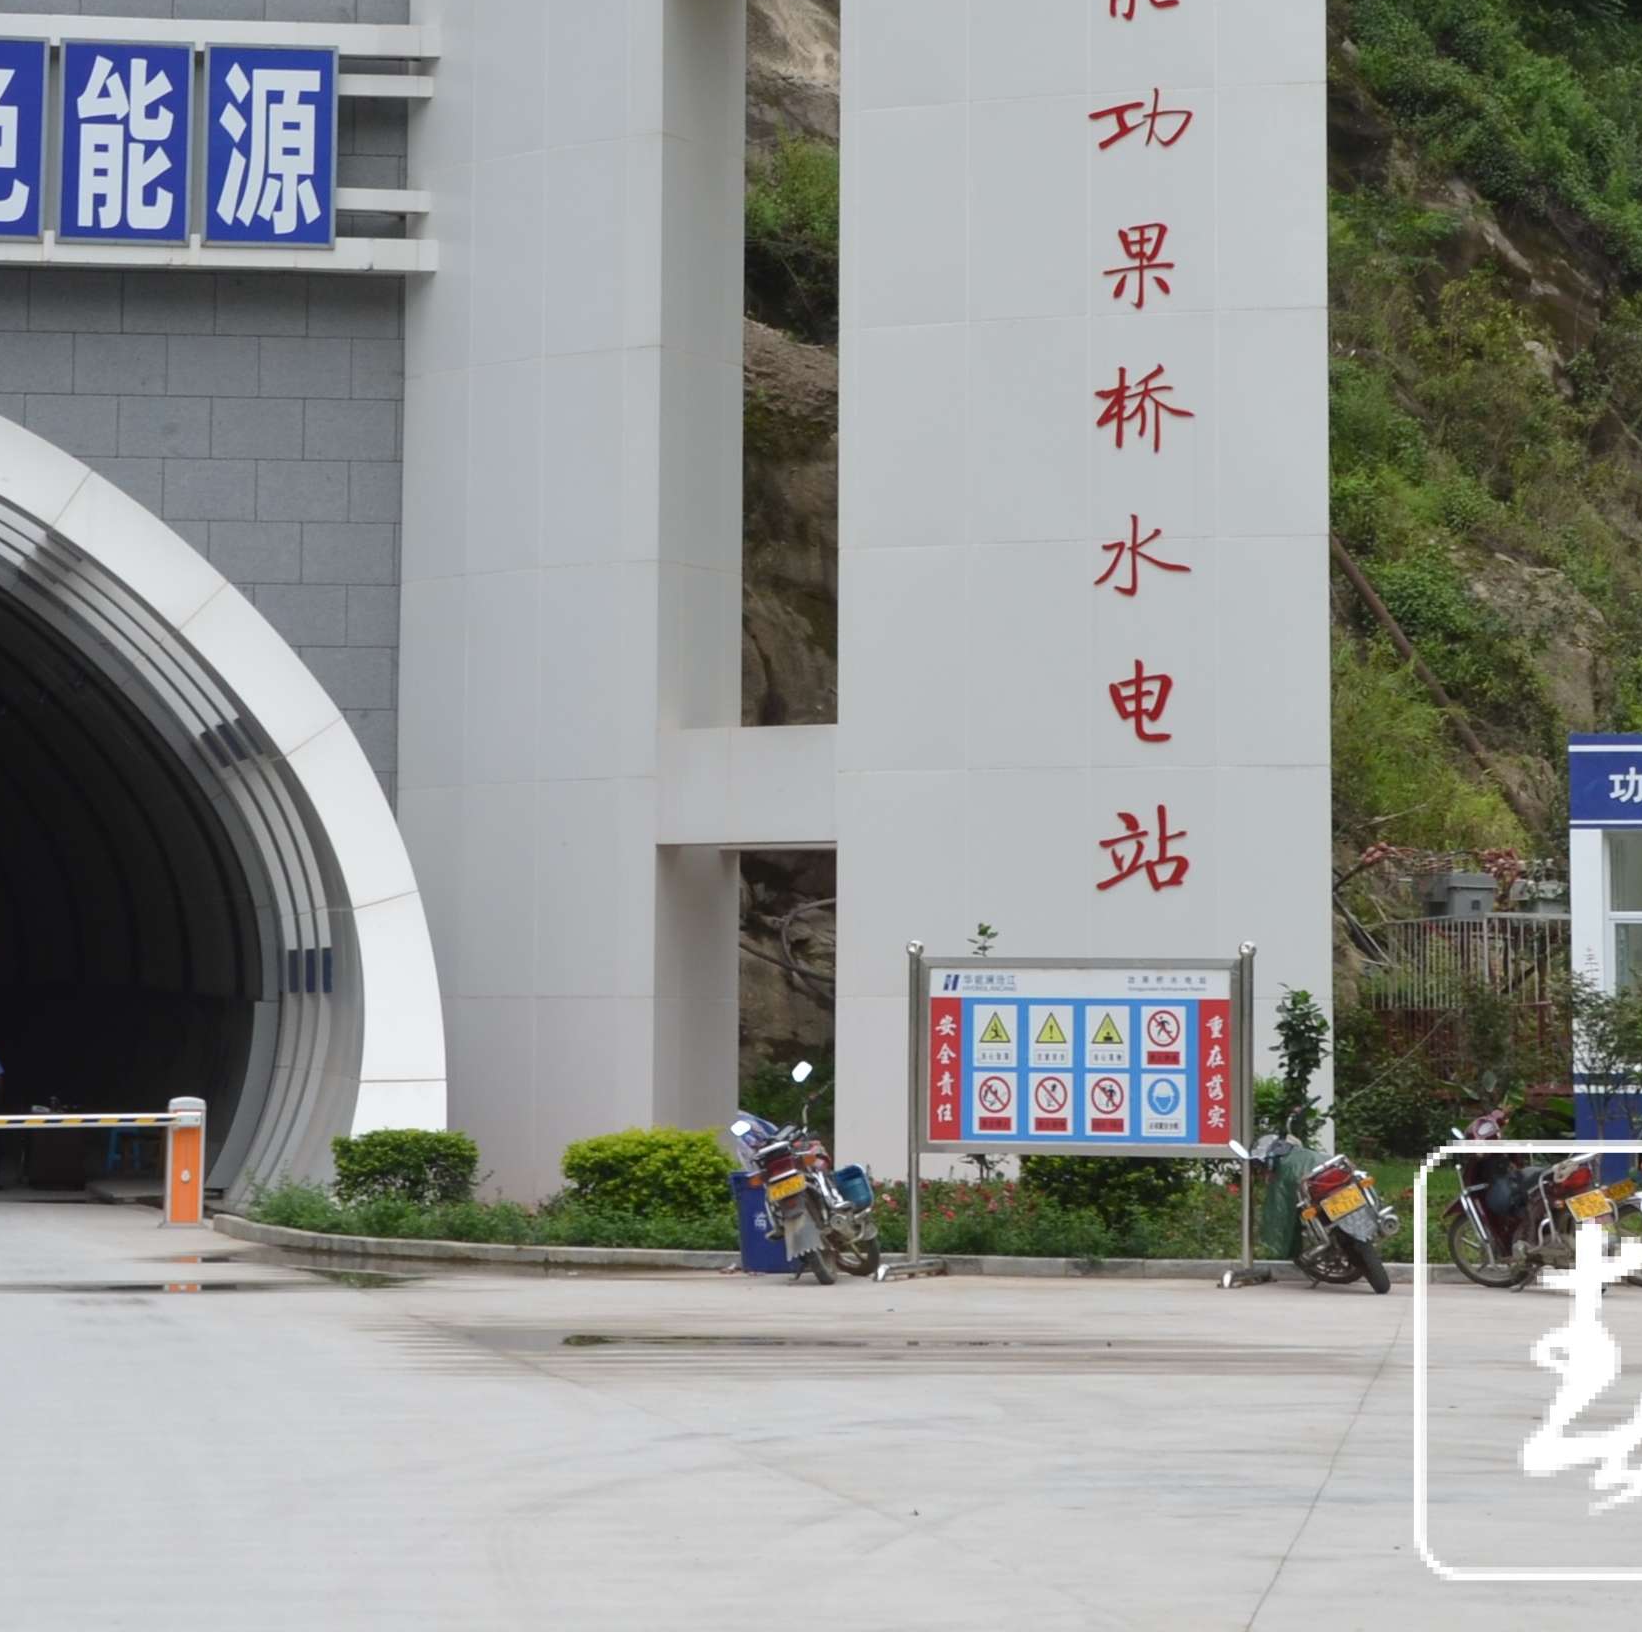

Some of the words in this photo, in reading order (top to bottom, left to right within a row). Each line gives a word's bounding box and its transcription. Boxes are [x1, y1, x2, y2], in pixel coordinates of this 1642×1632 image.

[935, 1015, 957, 1122] 安全责任
[1205, 1015, 1227, 1129] 重在落实
